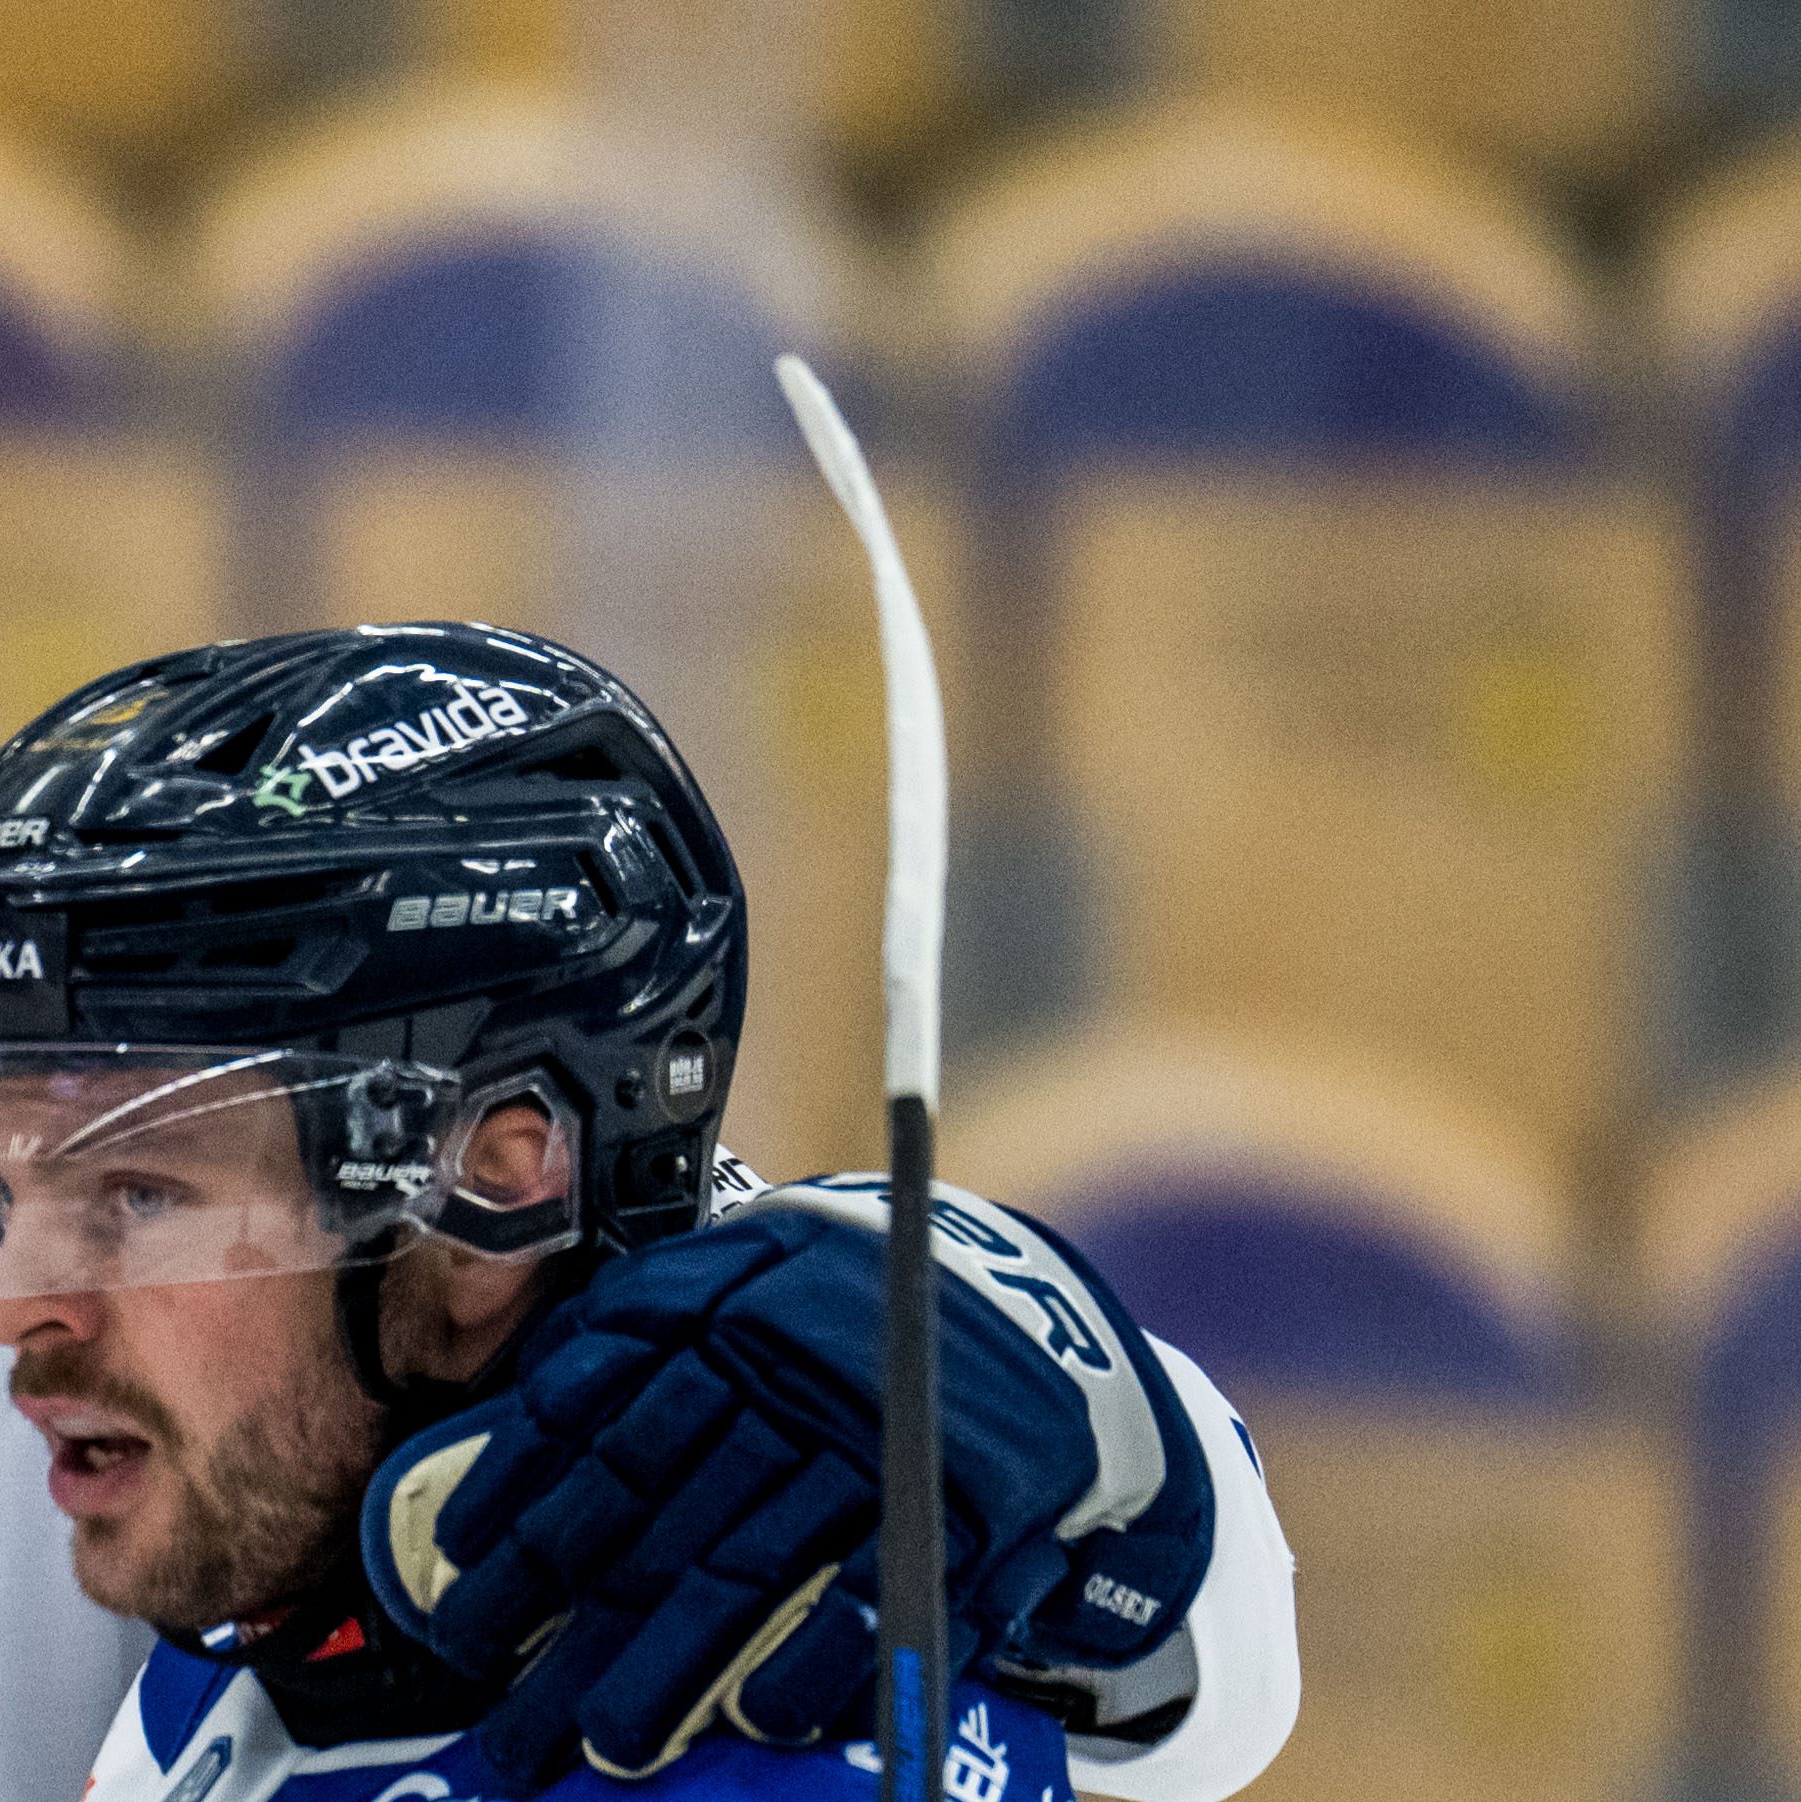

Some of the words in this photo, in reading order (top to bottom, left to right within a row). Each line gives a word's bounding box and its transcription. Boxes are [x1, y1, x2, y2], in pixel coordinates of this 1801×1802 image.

[299, 685, 529, 799] bravida
[387, 885, 578, 932] BAUER
[1085, 1574, 1161, 1626] OLSEN
